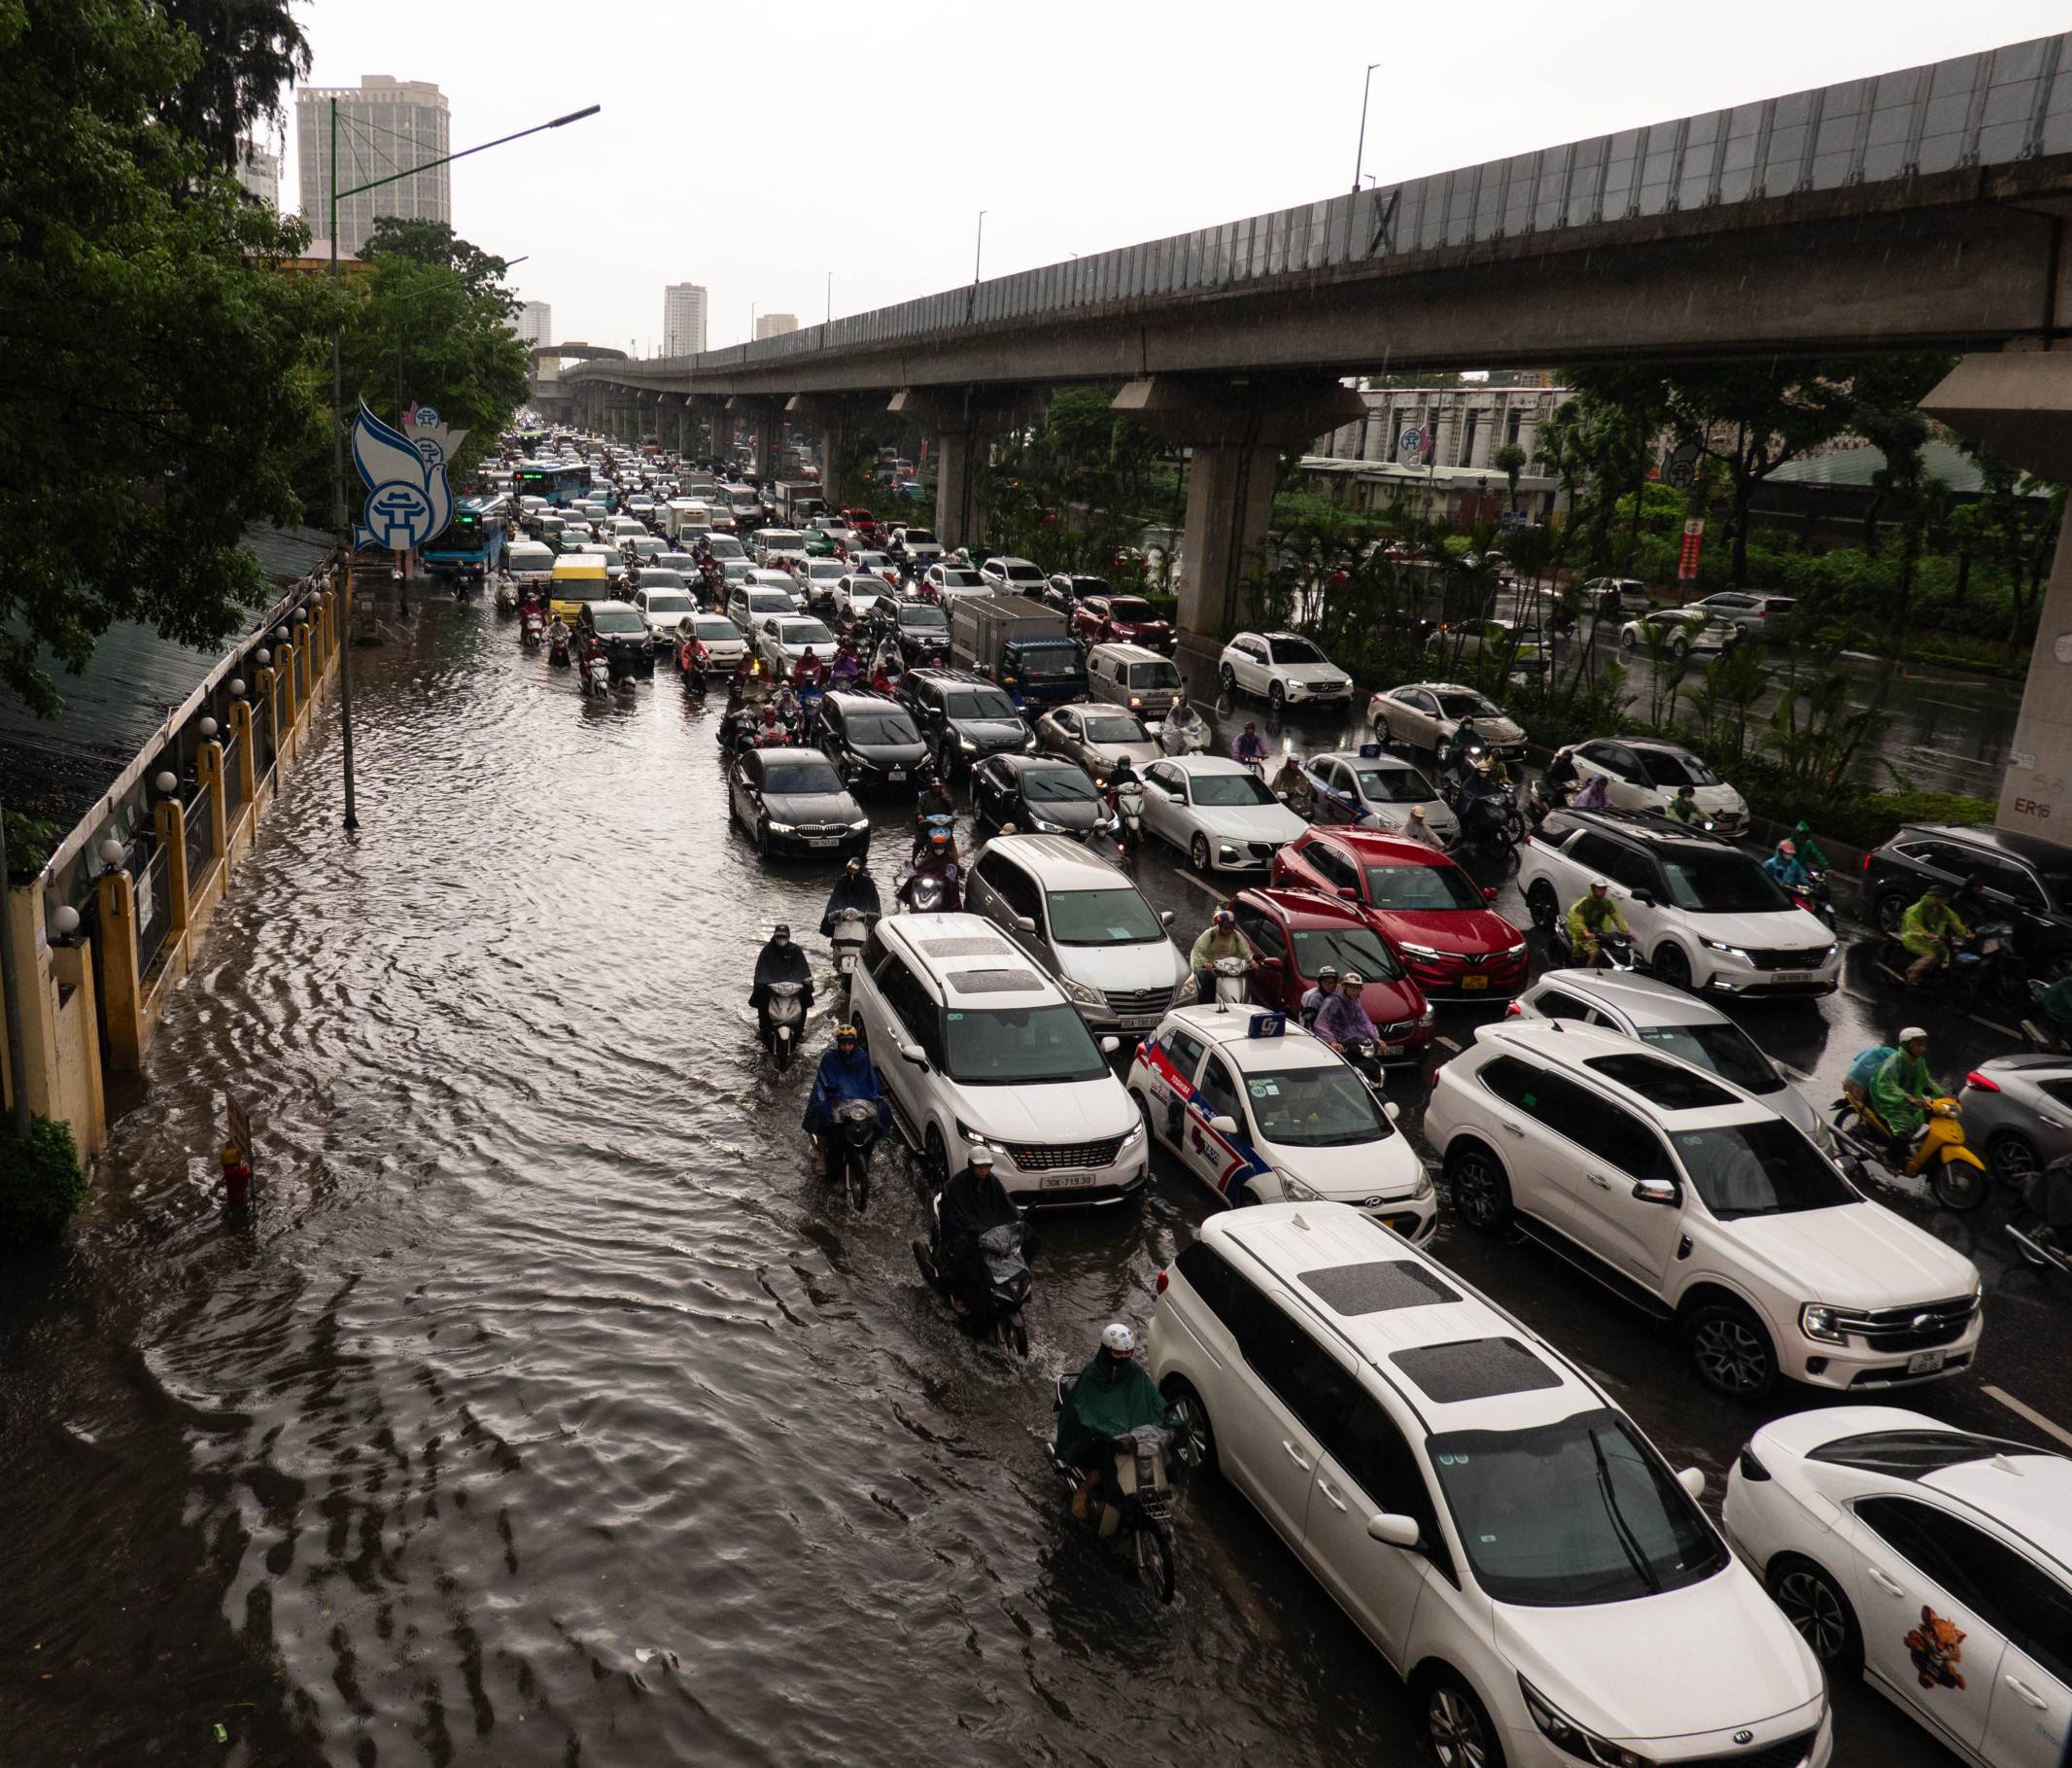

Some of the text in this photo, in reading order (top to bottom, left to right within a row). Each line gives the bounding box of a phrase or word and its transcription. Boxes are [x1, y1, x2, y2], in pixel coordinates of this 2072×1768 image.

[2015, 797, 2051, 818] ER16
[1261, 1018, 1278, 1035] G7
[1170, 1074, 1191, 1094] TOSHIBA
[1203, 1142, 1220, 1163] TAXI
[1046, 1176, 1091, 1188] 30K-719.30
[1735, 1731, 1752, 1742] KIA
